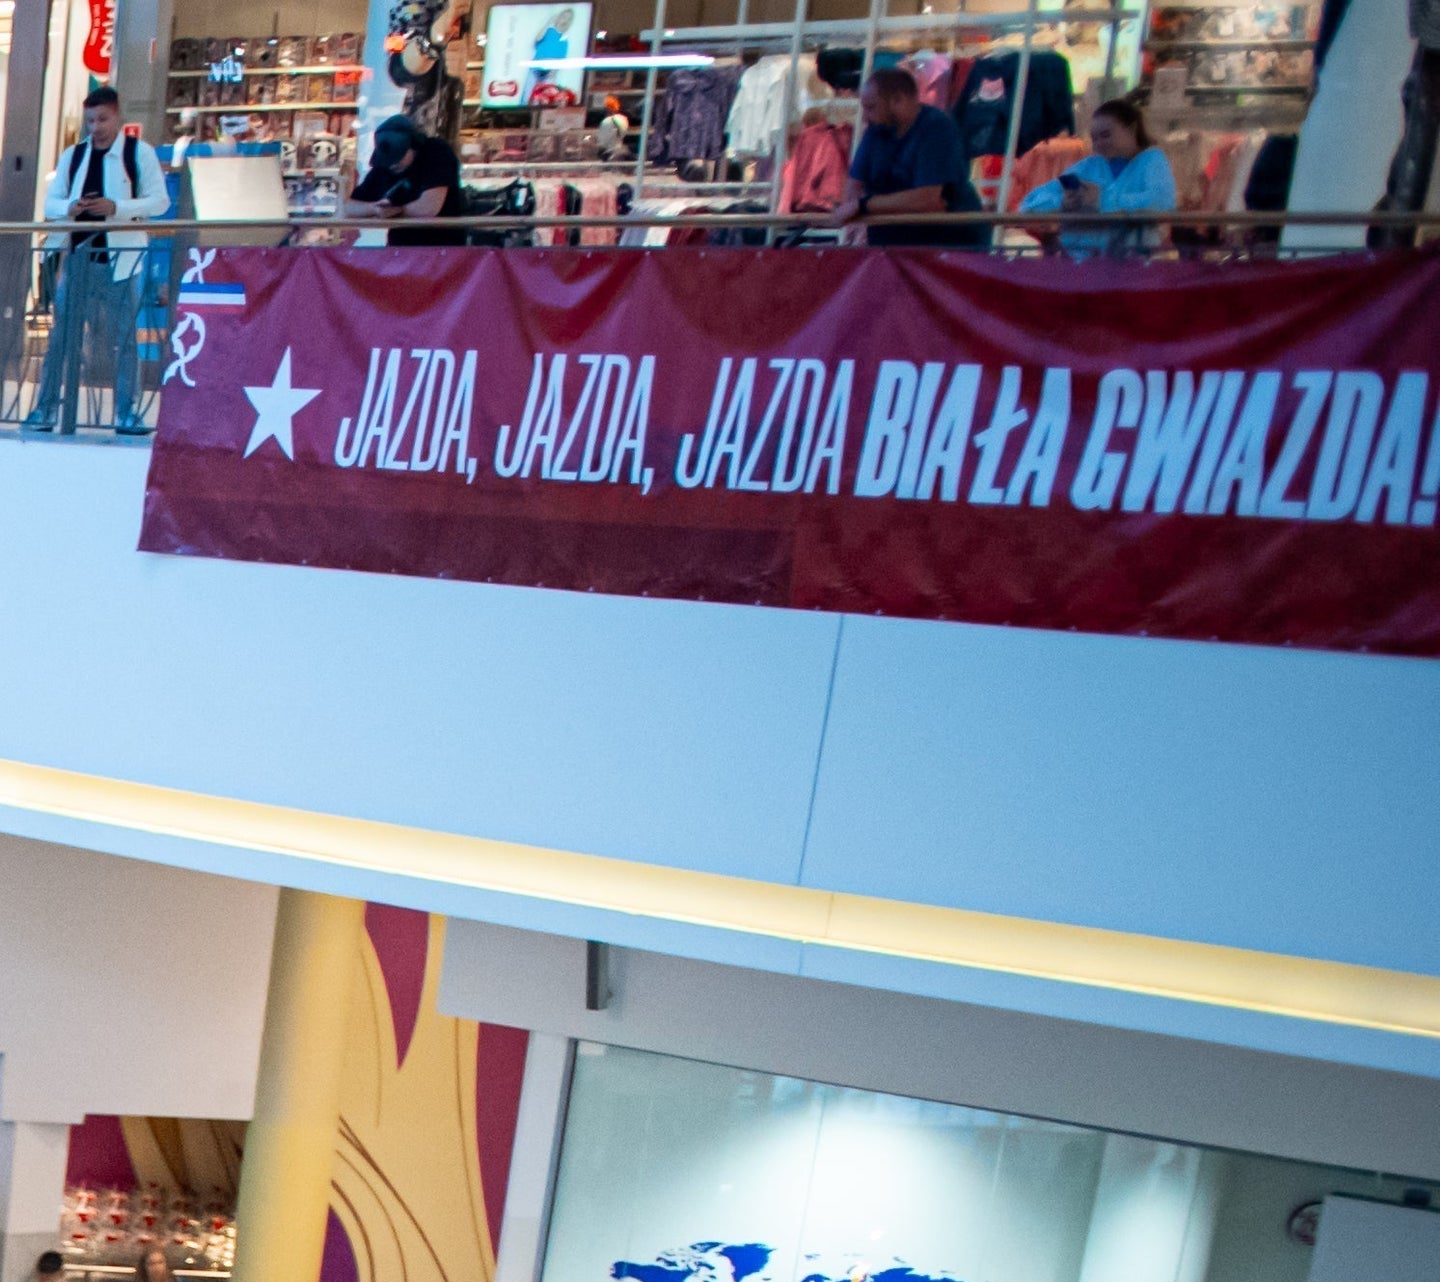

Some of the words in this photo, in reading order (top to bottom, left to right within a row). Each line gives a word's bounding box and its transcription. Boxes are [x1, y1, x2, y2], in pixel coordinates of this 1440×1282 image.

[334, 347, 478, 485] JAZDA,
[493, 352, 657, 496] JAZDA,
[673, 356, 855, 496] JAZDA
[854, 358, 1072, 507] BIAŁA
[1070, 367, 1440, 527] GWIAZDA!
